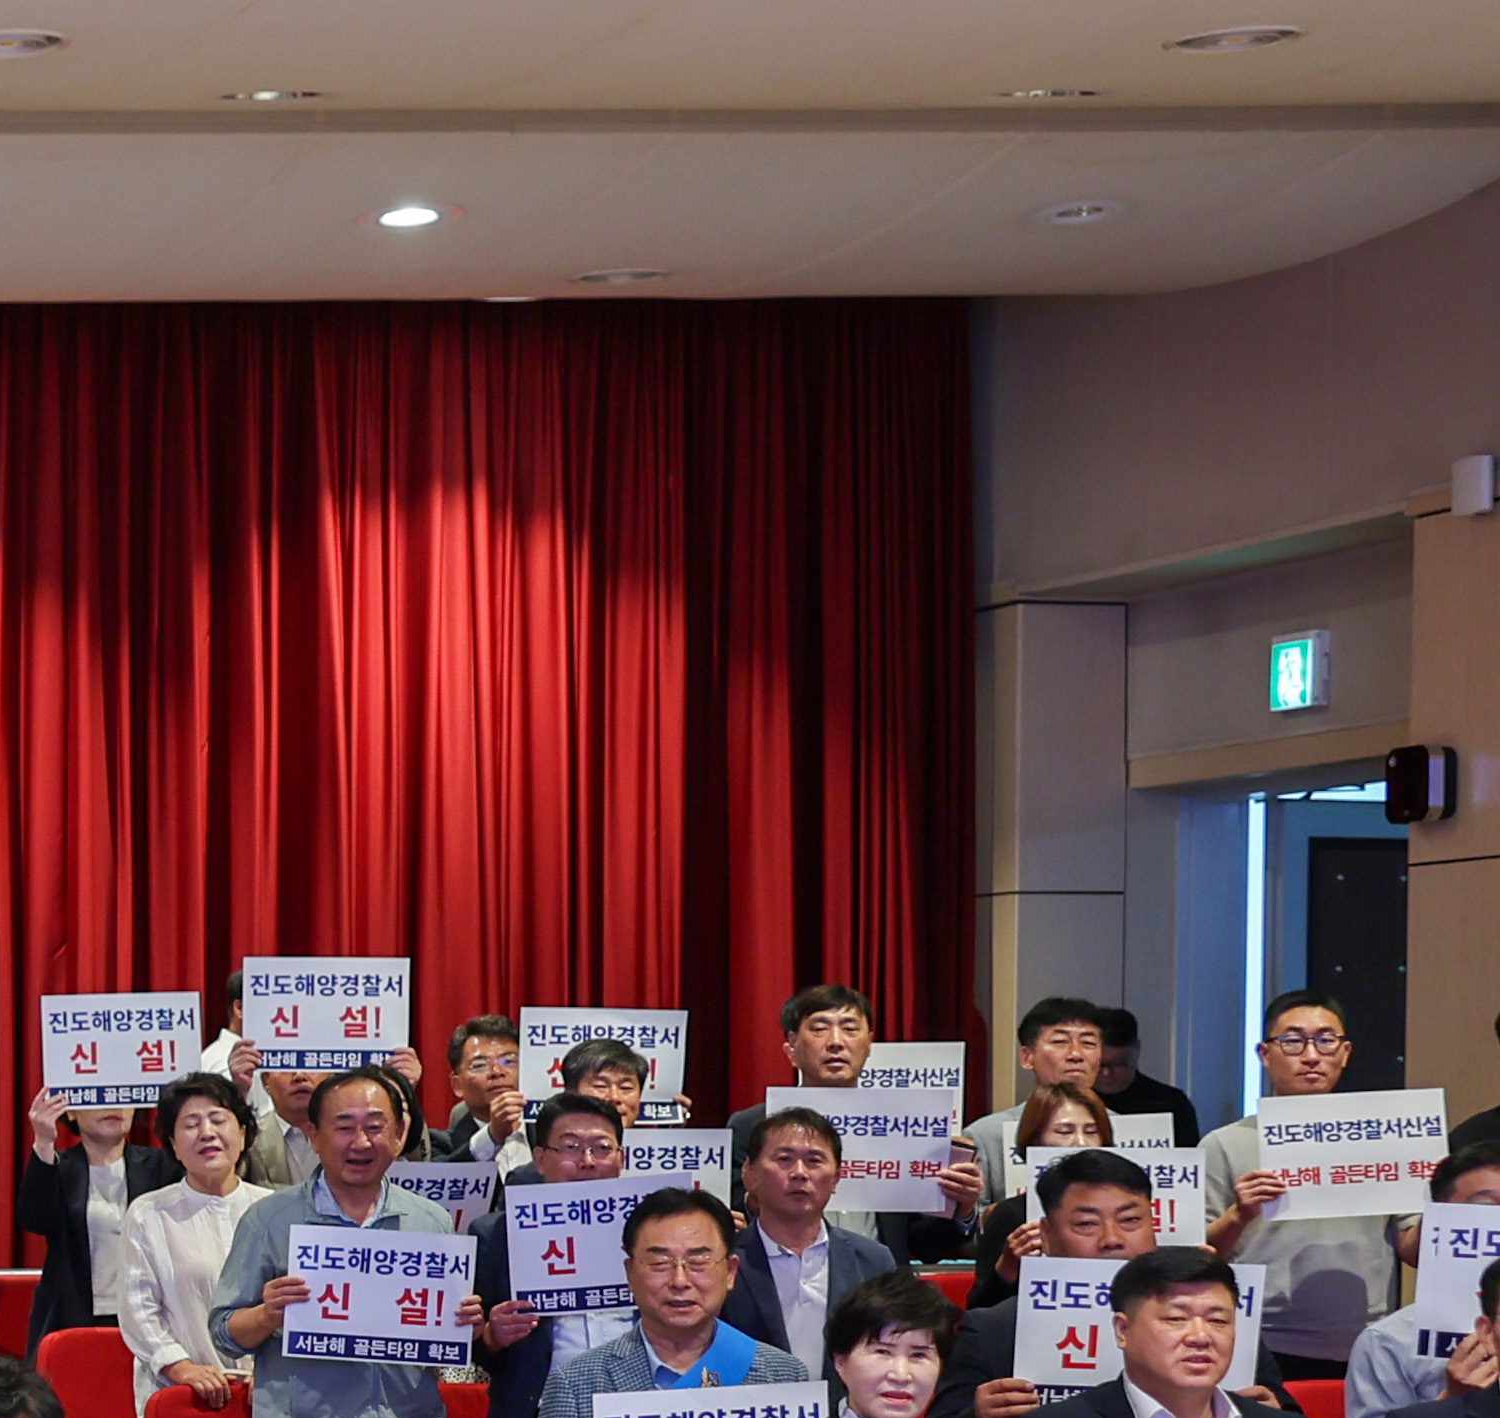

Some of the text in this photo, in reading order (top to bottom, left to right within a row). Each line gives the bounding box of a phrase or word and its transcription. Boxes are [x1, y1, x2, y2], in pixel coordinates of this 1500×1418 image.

[250, 973, 403, 998] 진도해양경찰서
[49, 1007, 195, 1034] 진도해양경찰서
[270, 1005, 381, 1039] 신 설!
[70, 1039, 176, 1075] 신 설!
[303, 1052, 362, 1068] 골든타임
[1263, 1115, 1443, 1146] 진도해양경찰서신설
[1329, 1161, 1399, 1185] 골든타임
[297, 1244, 470, 1281] 진도해양경찰서
[316, 1282, 445, 1327] 신 설!
[295, 1334, 460, 1361] 서남해 골든타임 확보
